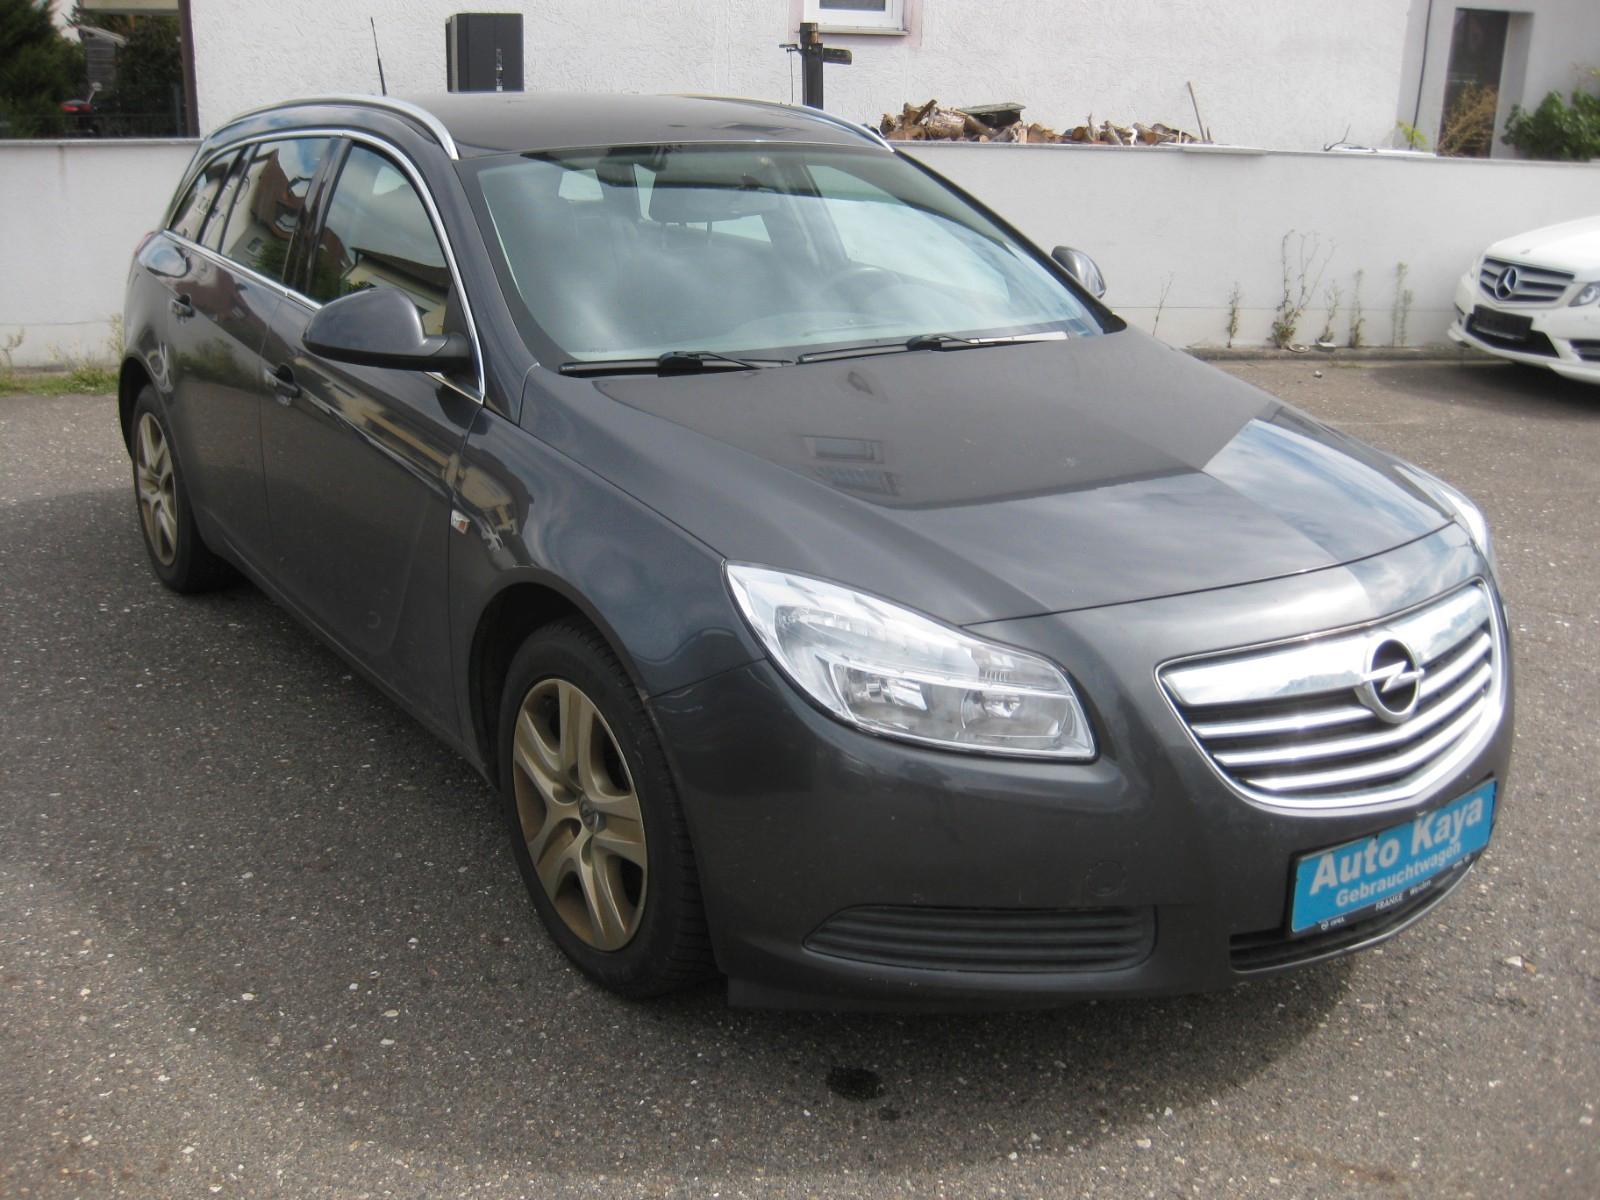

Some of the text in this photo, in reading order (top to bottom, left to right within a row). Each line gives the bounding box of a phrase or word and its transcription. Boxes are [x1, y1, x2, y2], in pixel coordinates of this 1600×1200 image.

[1309, 797, 1484, 896] Auto Kaya
[1336, 840, 1462, 907] Gebrauchtwagen
